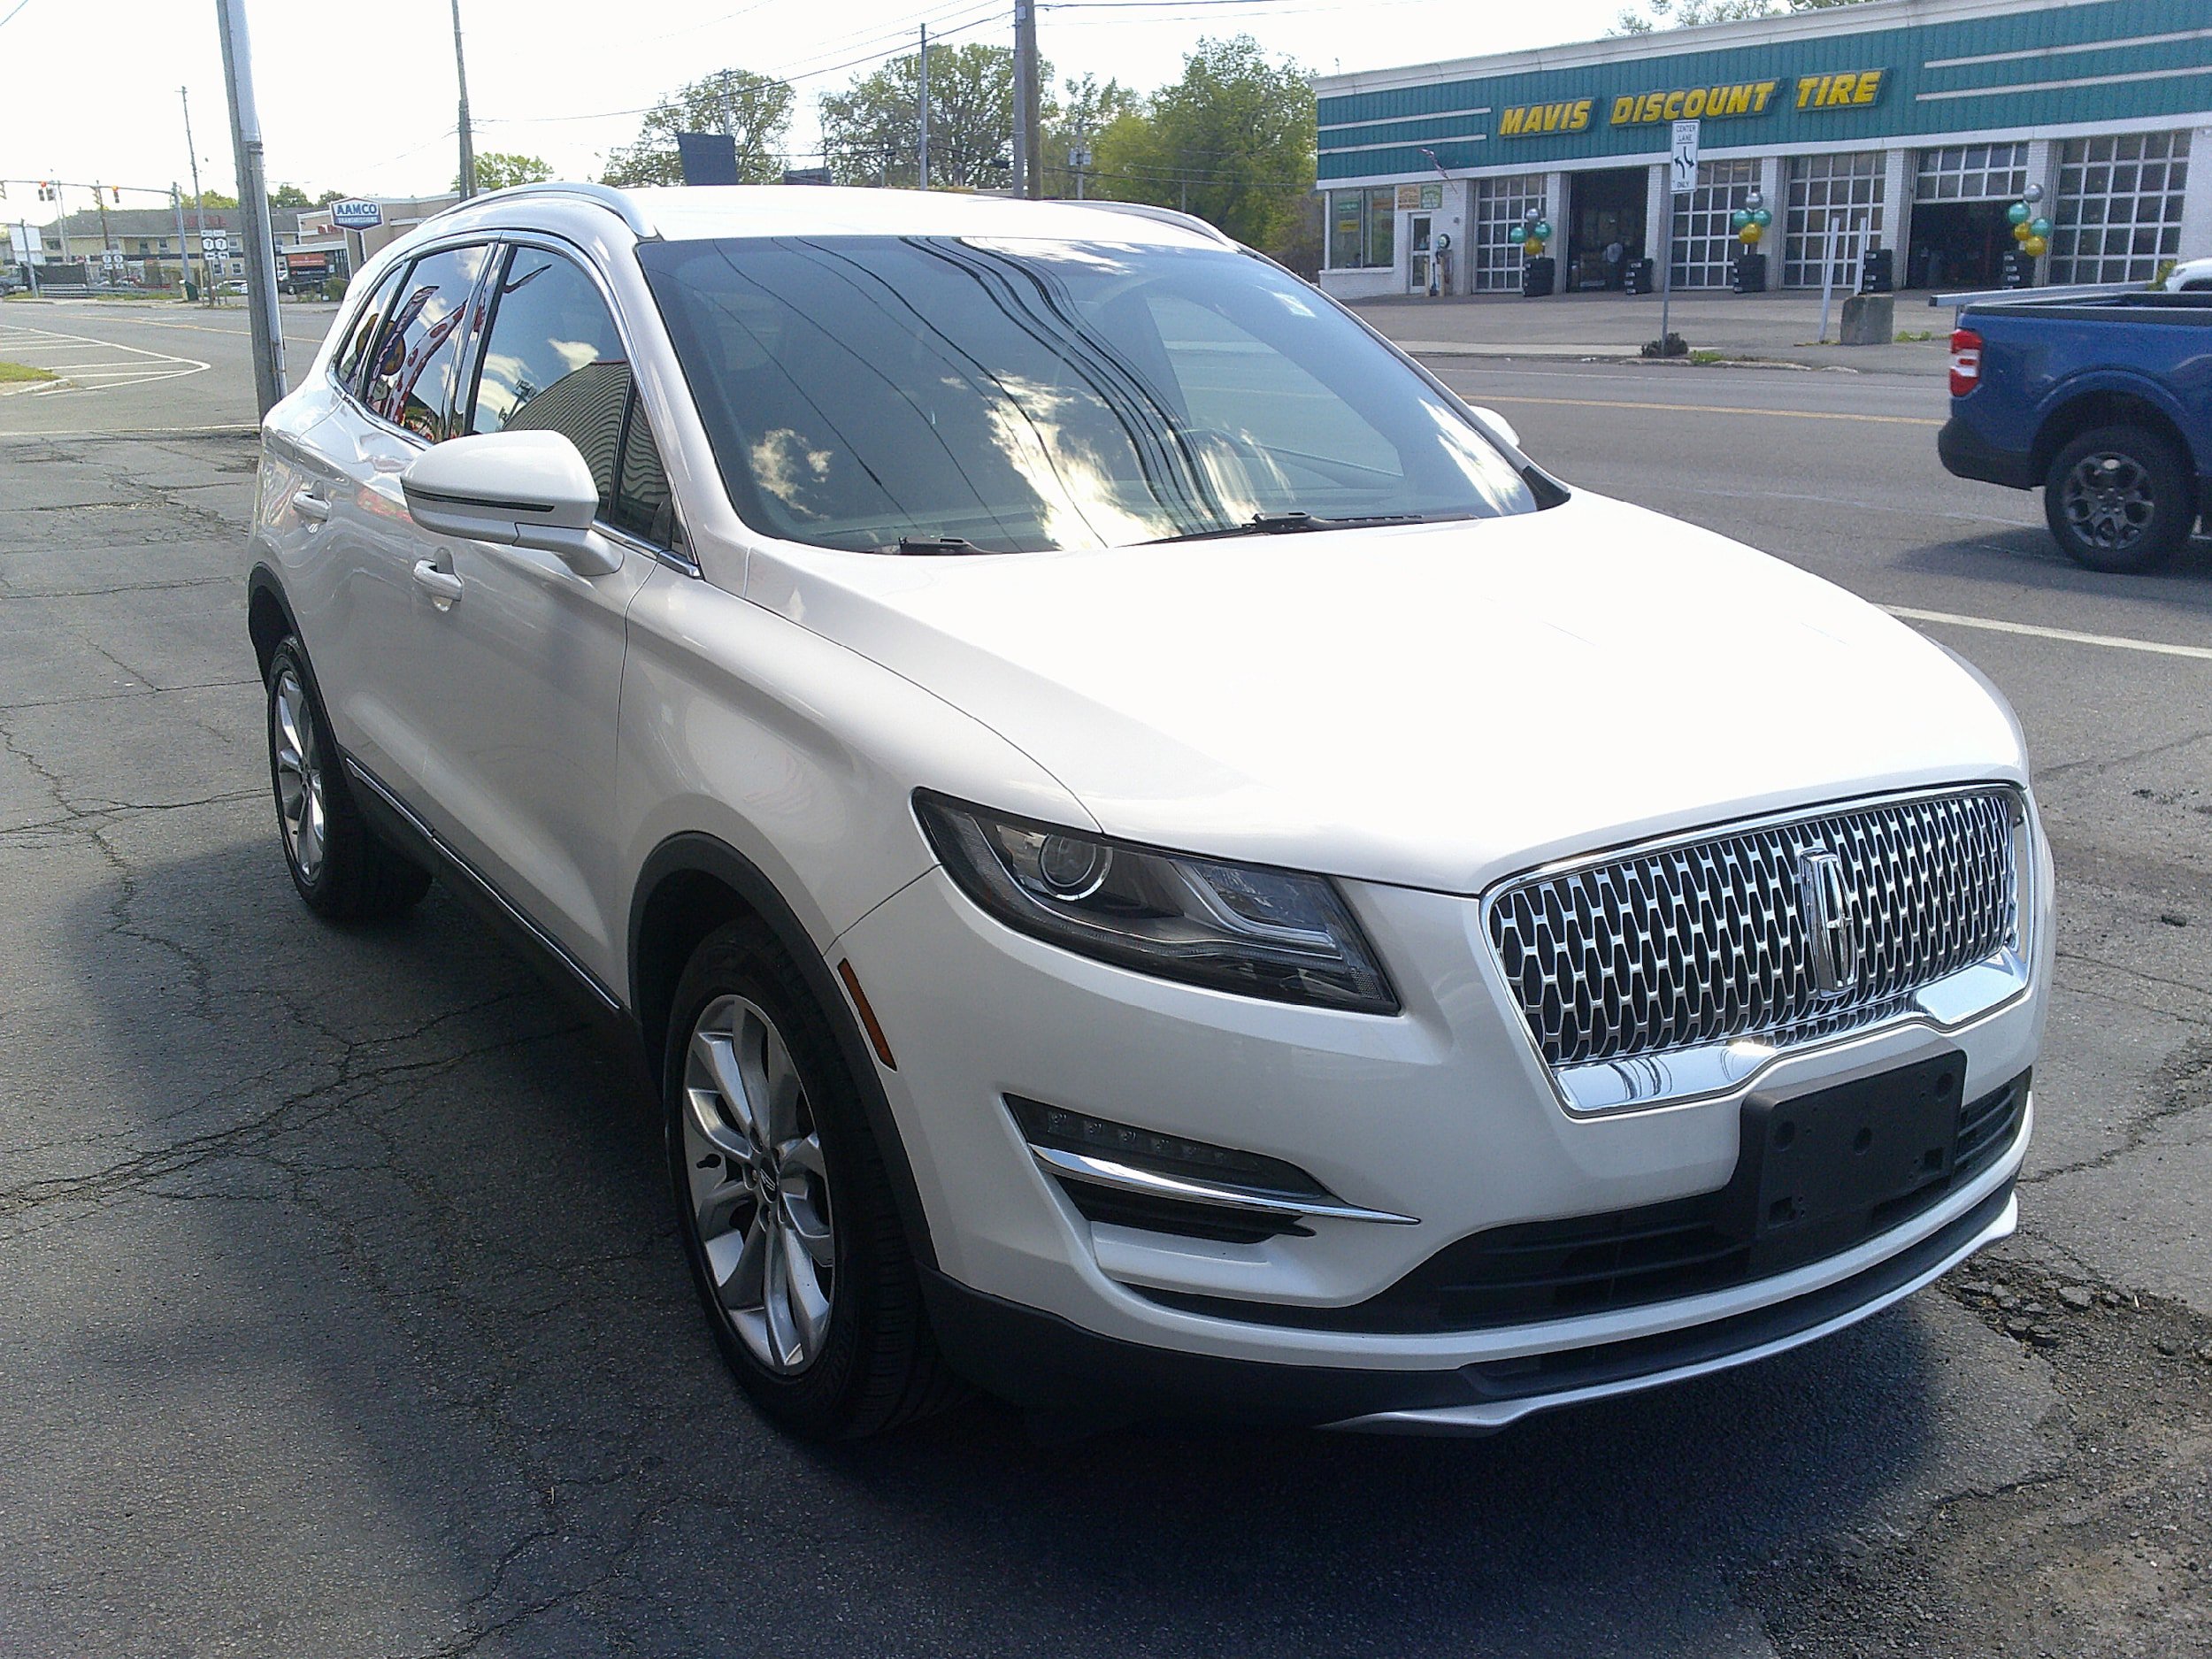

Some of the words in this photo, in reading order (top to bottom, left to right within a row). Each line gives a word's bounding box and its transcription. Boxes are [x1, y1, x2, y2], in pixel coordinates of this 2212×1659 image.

[1499, 100, 1592, 135] MAVIS
[1610, 81, 1775, 125] DISCOUNT
[1795, 71, 1882, 108] TIRE
[336, 204, 377, 214] AAMCO
